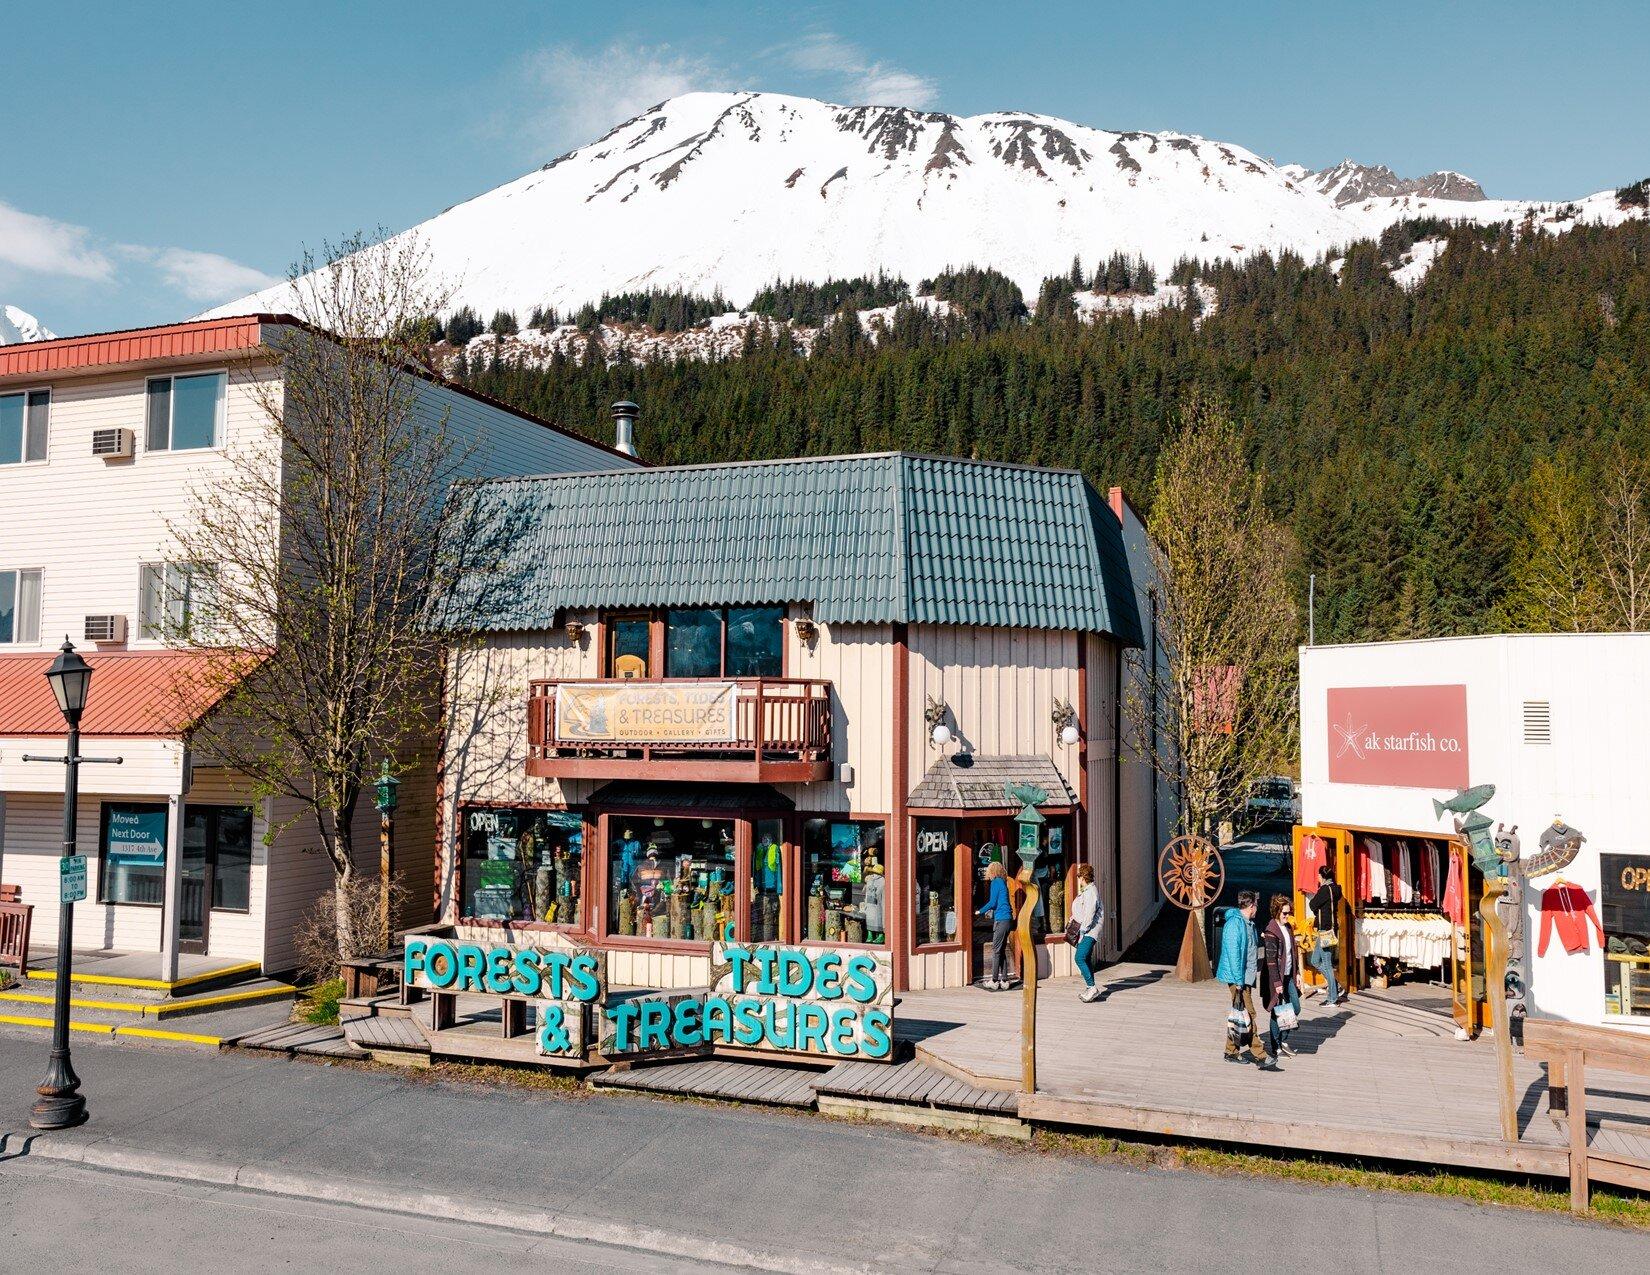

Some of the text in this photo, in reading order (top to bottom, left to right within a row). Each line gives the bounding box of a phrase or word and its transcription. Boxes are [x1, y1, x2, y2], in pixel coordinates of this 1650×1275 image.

[619, 708, 726, 724] & TREASURES
[705, 728, 726, 736] GIFTS
[1364, 732, 1462, 752] ak starfish co.
[112, 813, 139, 824] Moved
[470, 812, 499, 831] OPEN
[111, 828, 150, 839] Next Door
[916, 830, 948, 853] OPEN
[71, 882, 79, 890] TO
[1621, 866, 1650, 892] OP
[405, 941, 876, 1003] FORESTS TIDES
[541, 996, 892, 1058] & TREASURES
